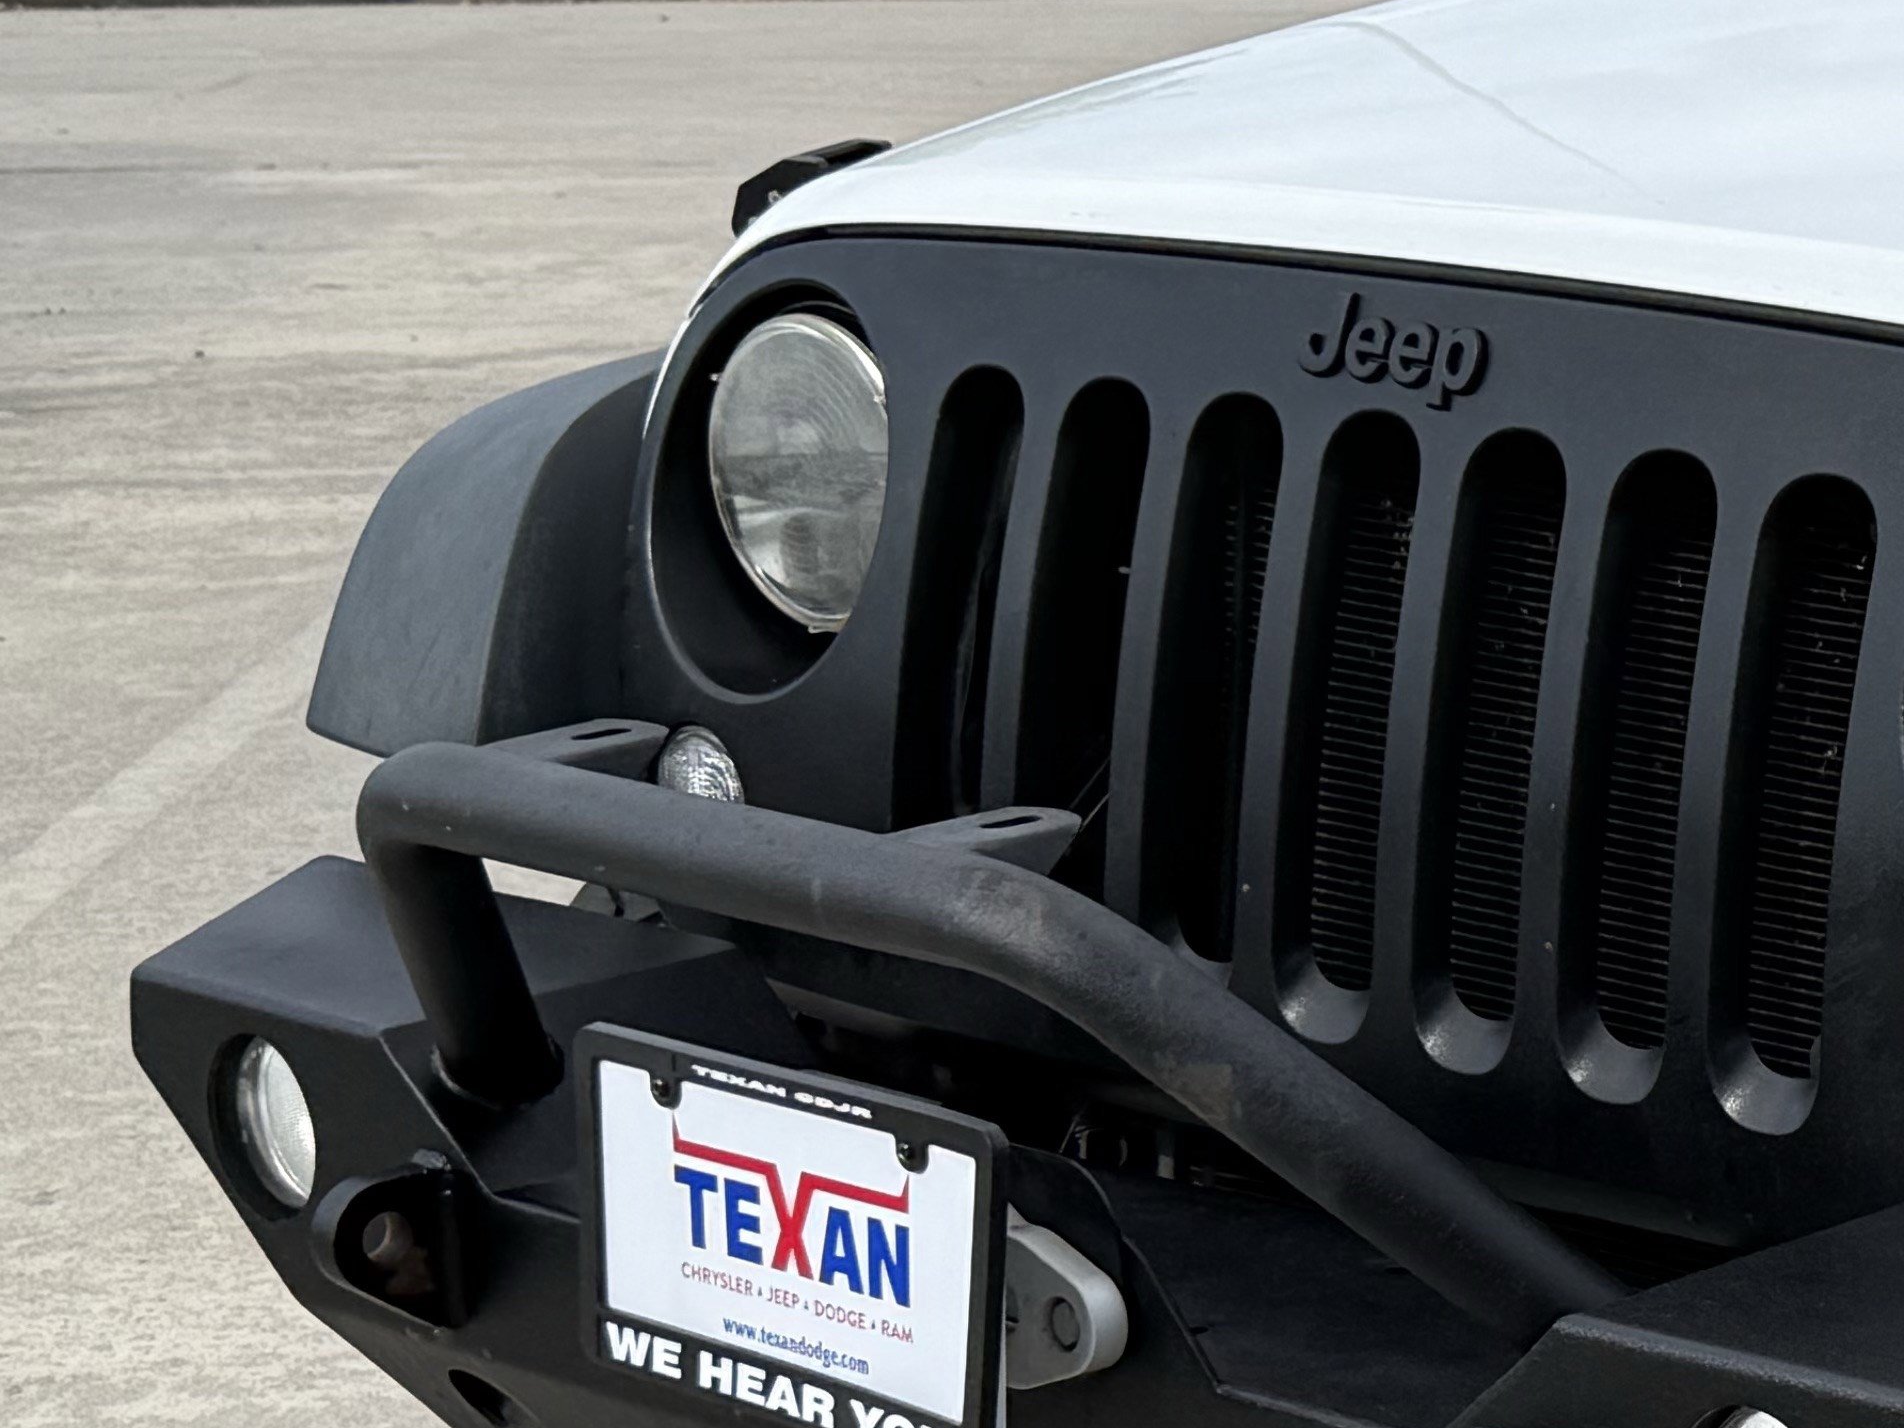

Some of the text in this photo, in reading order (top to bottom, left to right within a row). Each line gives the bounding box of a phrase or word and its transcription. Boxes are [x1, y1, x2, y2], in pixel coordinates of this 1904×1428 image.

[1299, 291, 1490, 412] Jeep
[690, 1063, 788, 1099] TEXAN
[671, 1112, 911, 1308] TEXAN
[681, 1261, 915, 1344] CHRYSLER JEEP DODGE RAM
[605, 1320, 682, 1380] WE
[722, 1316, 871, 1376] www.texandodge.com
